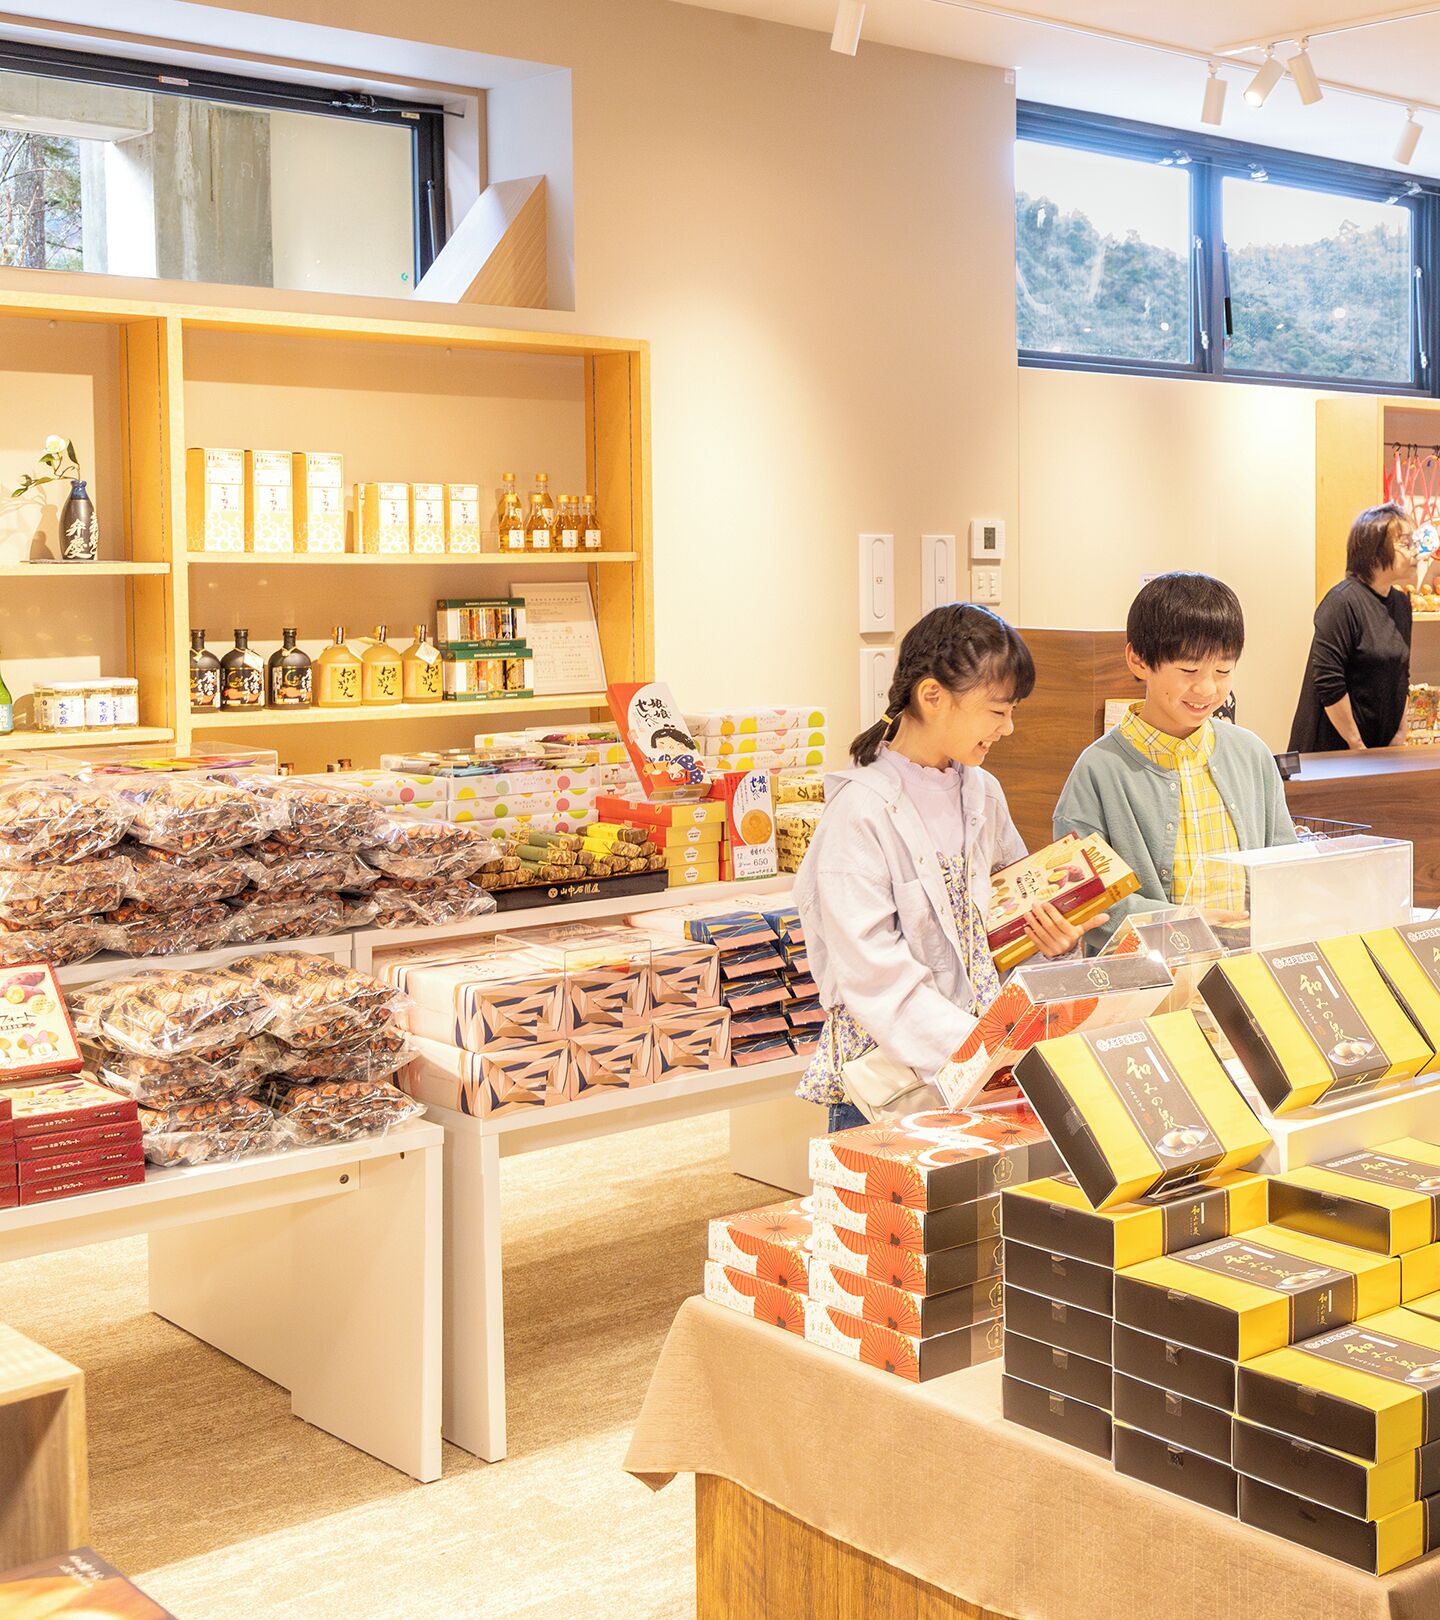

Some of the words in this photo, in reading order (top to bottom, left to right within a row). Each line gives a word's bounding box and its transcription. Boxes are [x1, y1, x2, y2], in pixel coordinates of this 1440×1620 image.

[635, 698, 660, 727] せんべい
[753, 857, 769, 866] 650
[1299, 973, 1358, 1041] 和みの泉
[1126, 1056, 1189, 1131] 和みの泉
[1343, 1342, 1422, 1371] 和みの泉
